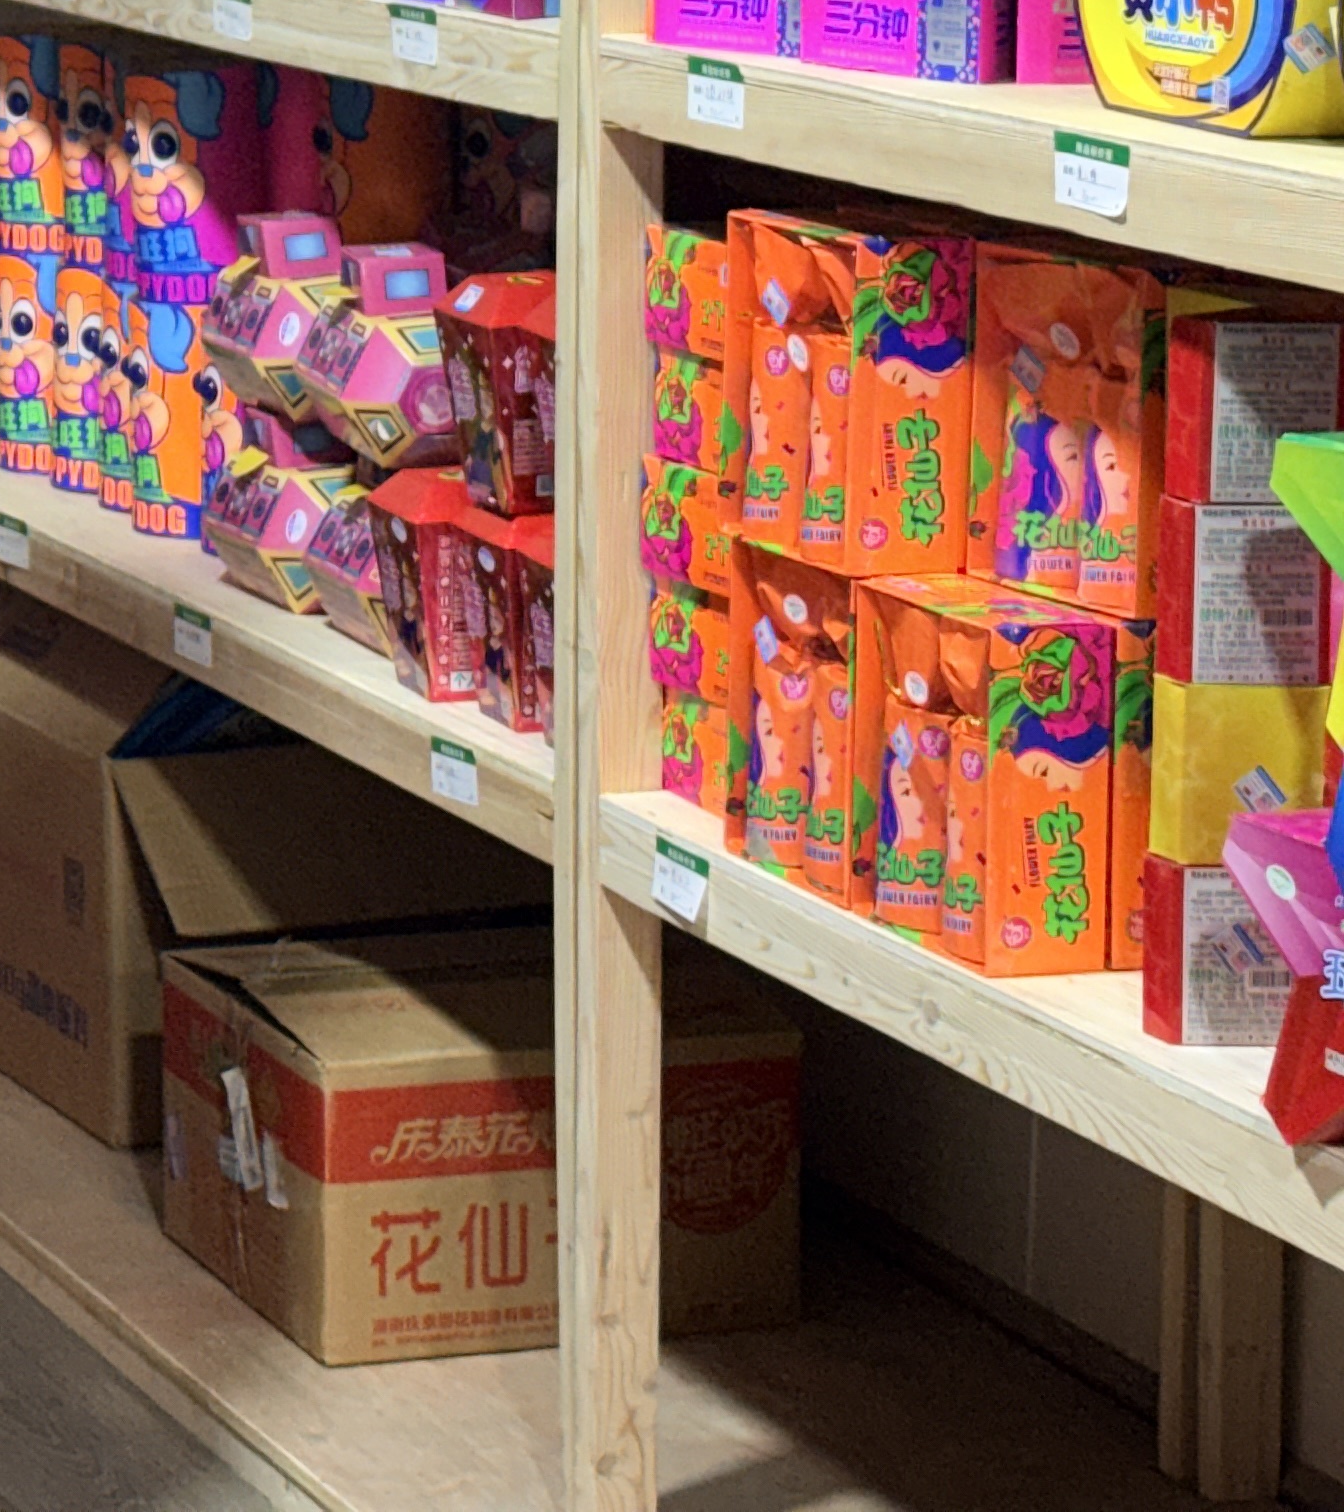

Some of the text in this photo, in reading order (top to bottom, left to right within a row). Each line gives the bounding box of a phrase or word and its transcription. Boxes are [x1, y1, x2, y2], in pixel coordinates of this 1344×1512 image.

[823, 0, 910, 43] 三分钟
[139, 227, 197, 263] 旺狗
[896, 407, 945, 549] 花仙子
[1037, 800, 1091, 946] 花仙子
[370, 1200, 559, 1300] 花仙
